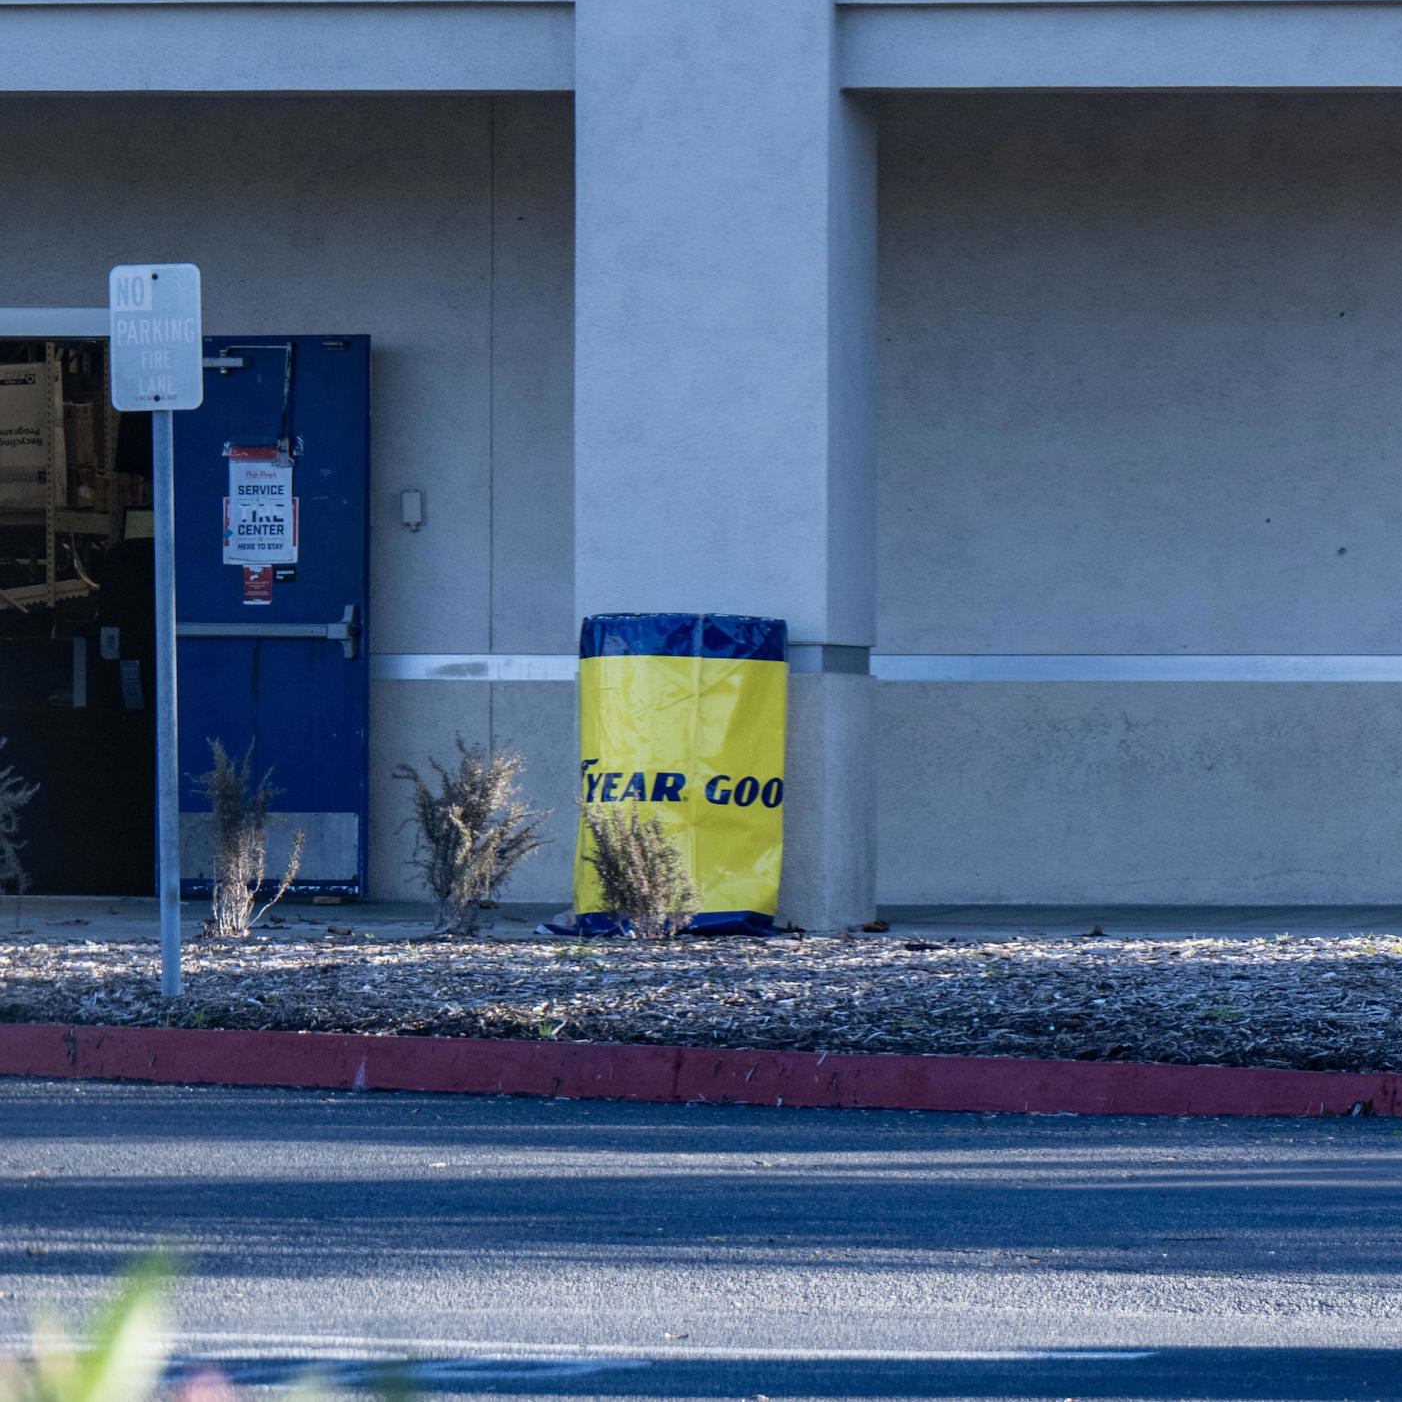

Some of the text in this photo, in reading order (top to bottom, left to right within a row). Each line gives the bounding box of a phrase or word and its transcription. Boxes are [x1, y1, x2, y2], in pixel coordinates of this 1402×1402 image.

[115, 276, 145, 308] NO
[116, 317, 195, 346] PARKING
[141, 349, 170, 370] FIRE
[138, 374, 176, 395] LANE
[238, 484, 284, 496] SERVICE
[237, 524, 284, 536] CENTER
[586, 771, 687, 803] YEAR
